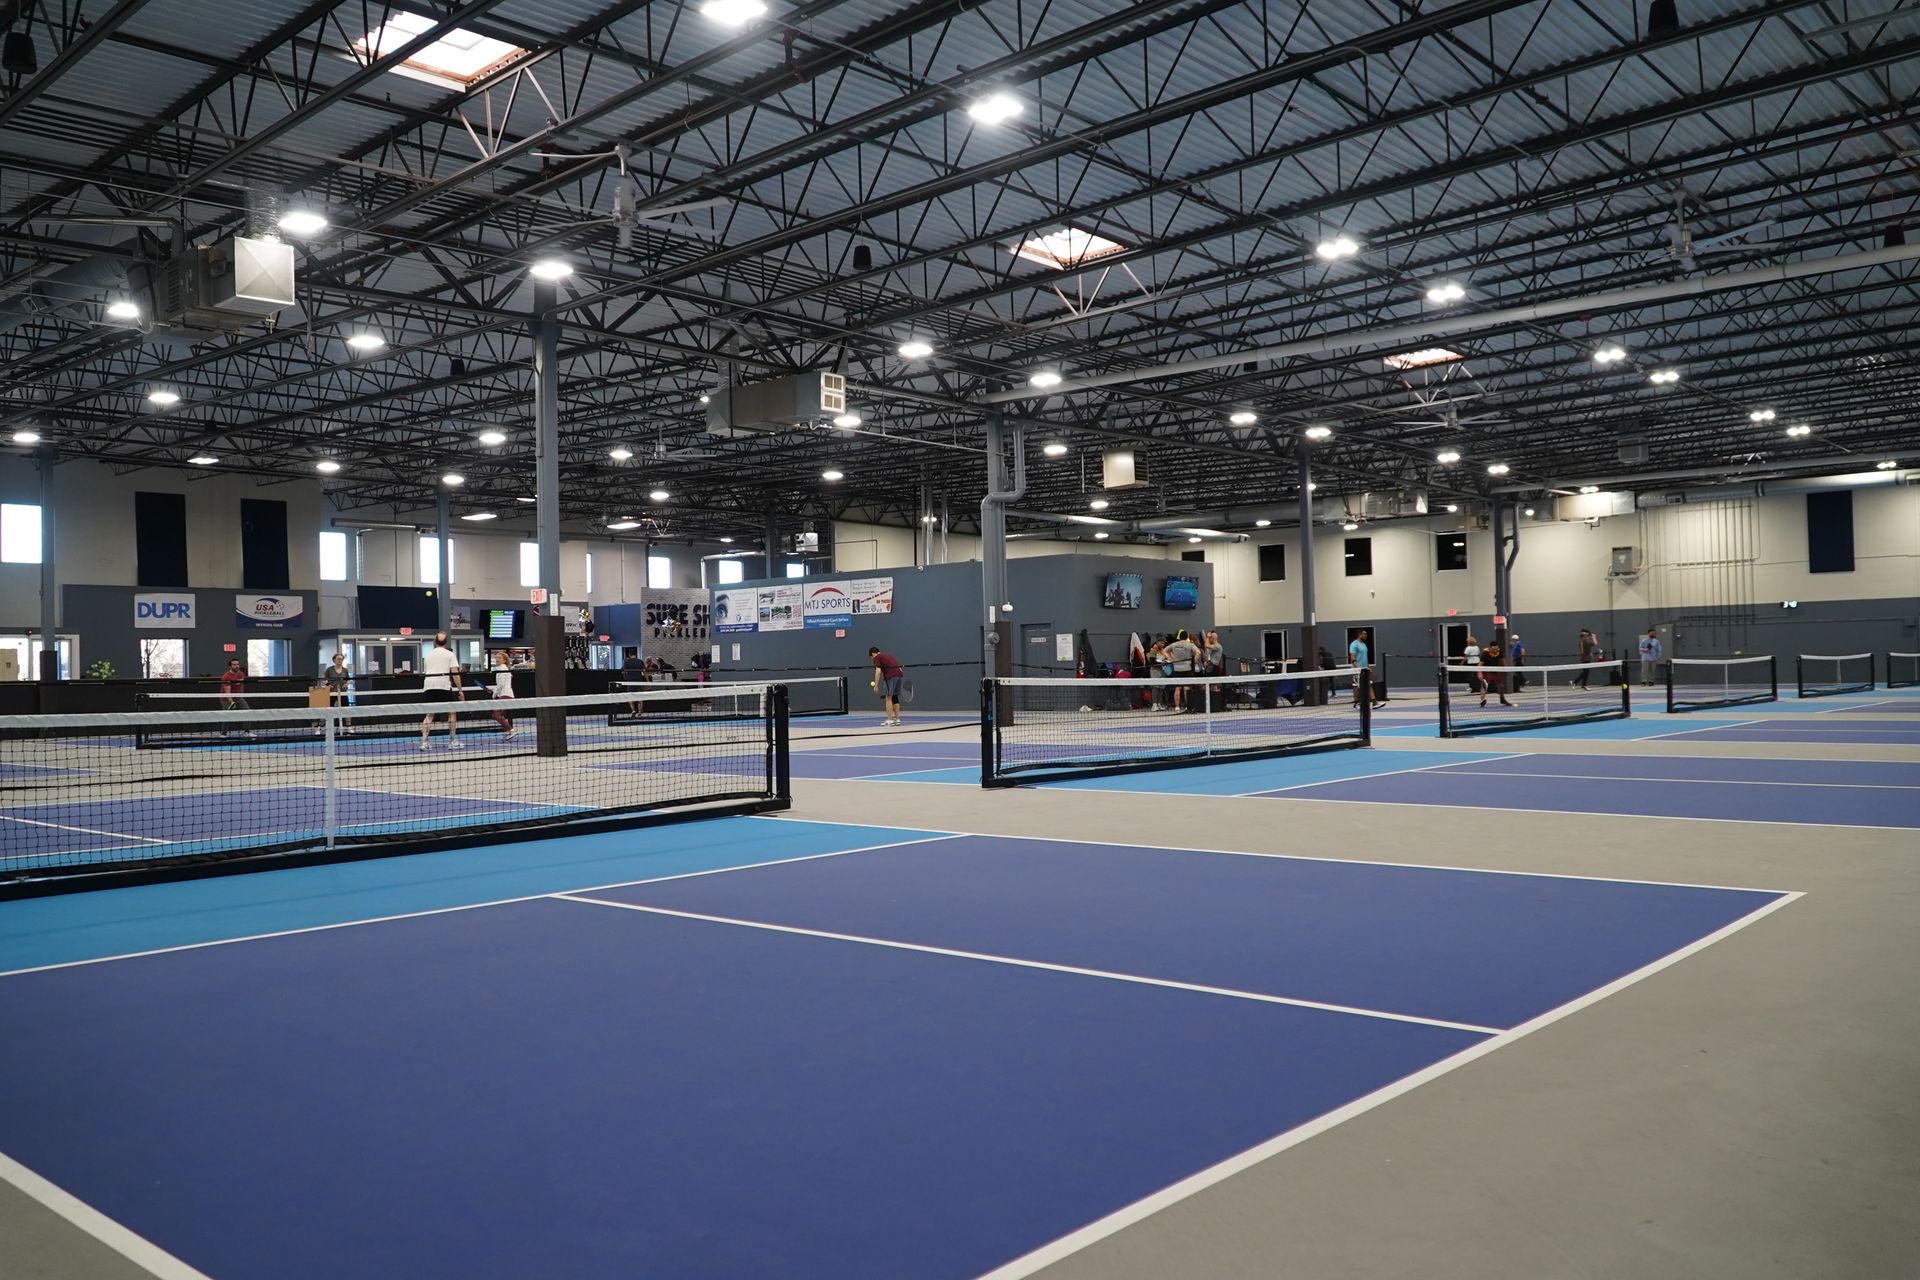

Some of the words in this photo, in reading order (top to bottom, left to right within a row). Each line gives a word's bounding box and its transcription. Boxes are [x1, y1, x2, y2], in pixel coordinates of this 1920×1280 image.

[137, 602, 192, 619] DUPR
[805, 600, 819, 610] MTJ
[822, 598, 851, 609] SPORTS
[646, 604, 688, 625] SURE
